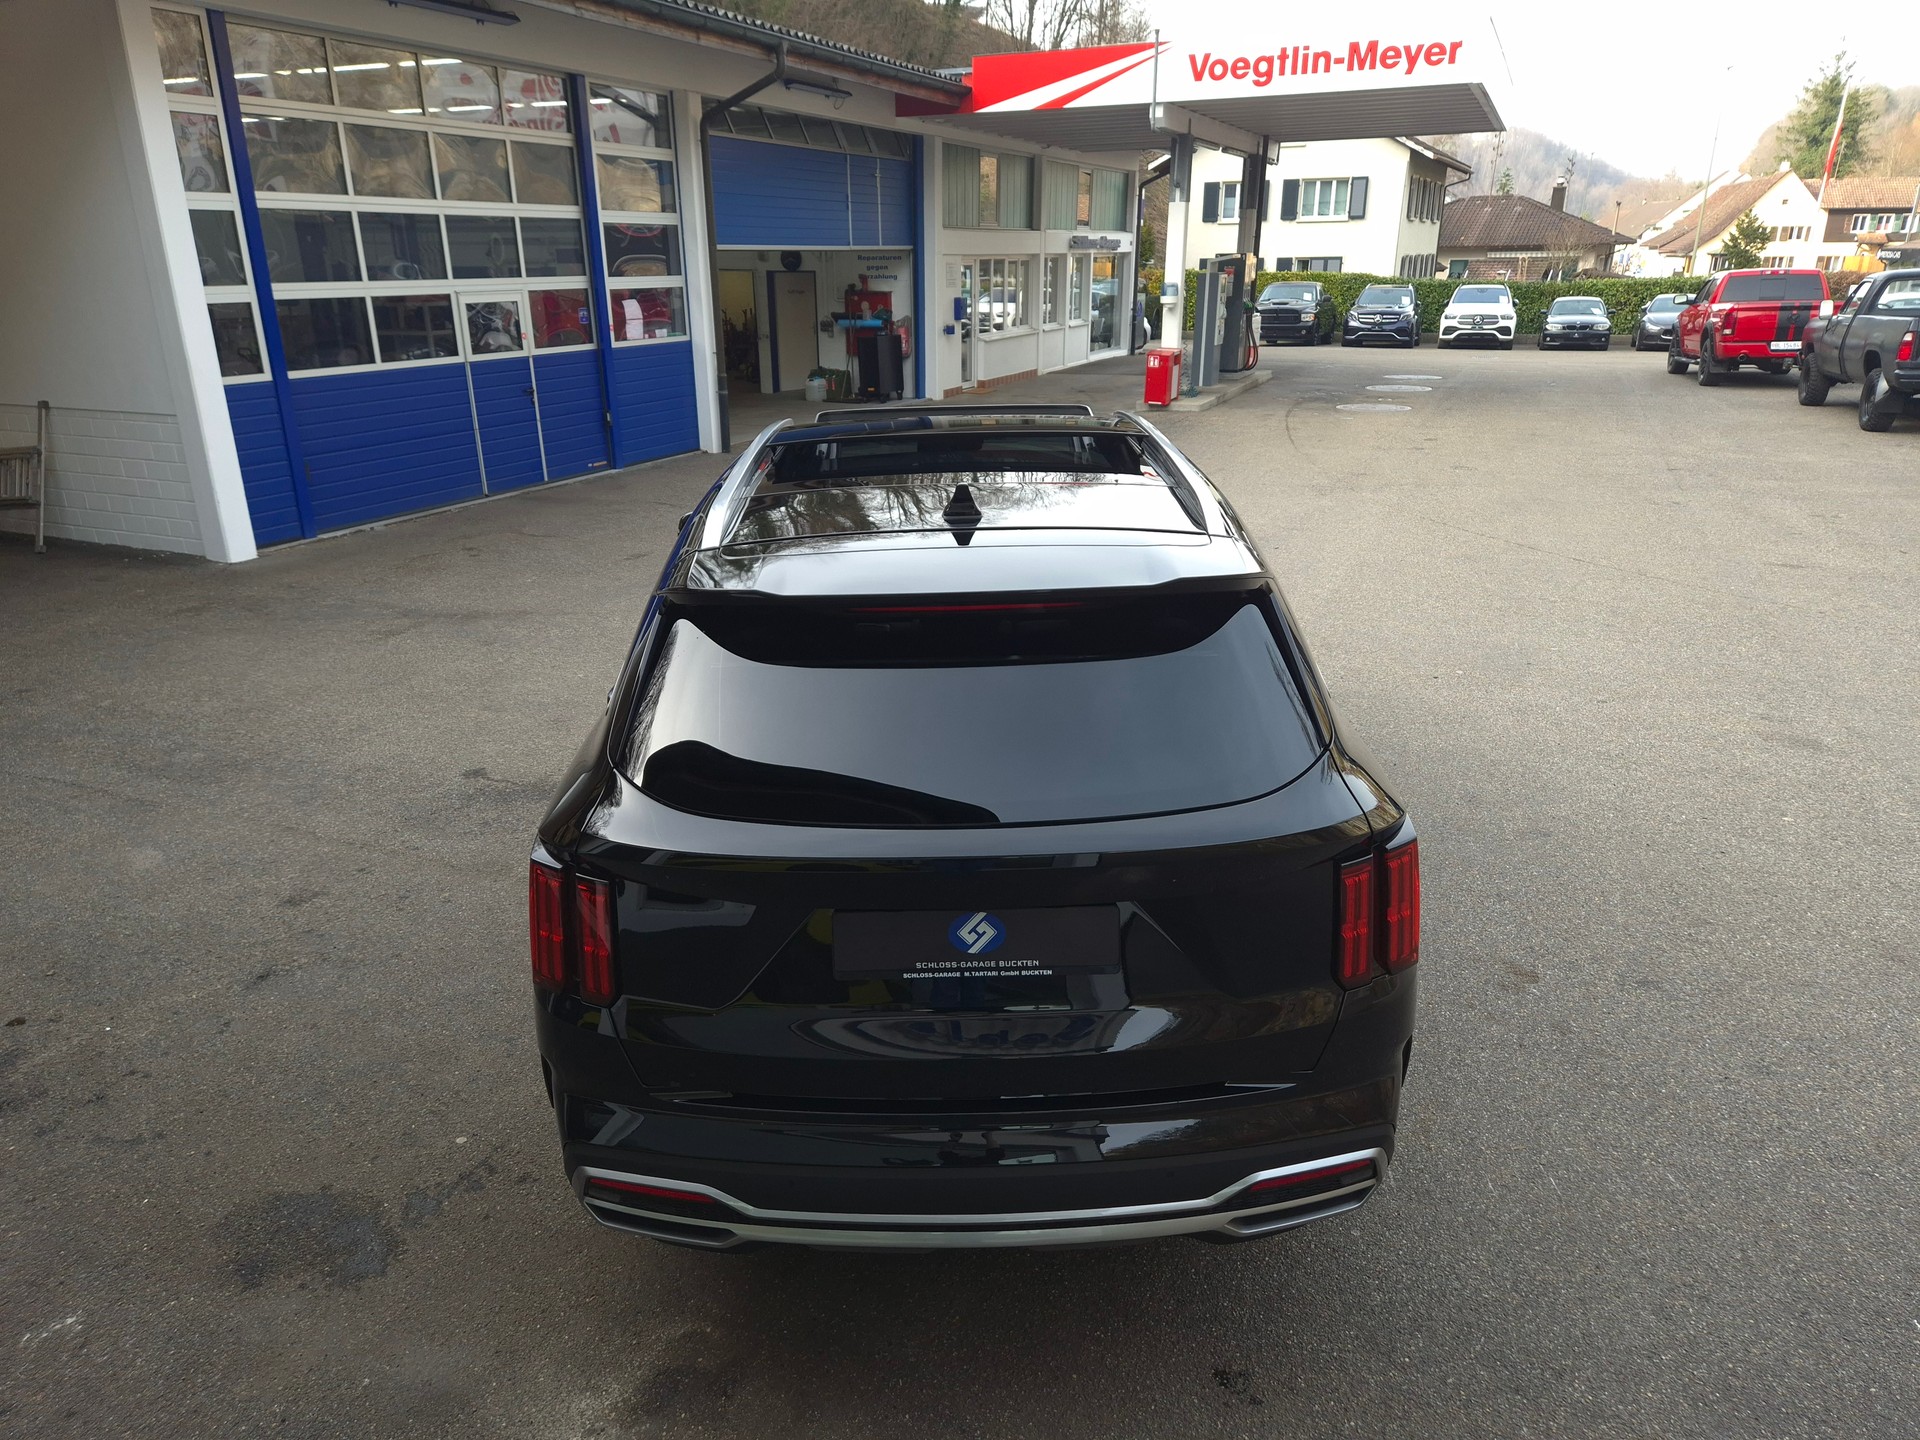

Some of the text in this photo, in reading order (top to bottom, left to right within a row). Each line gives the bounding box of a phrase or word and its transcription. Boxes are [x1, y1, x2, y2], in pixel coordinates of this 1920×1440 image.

[1188, 40, 1463, 87] Voegtlin-Meyer
[857, 254, 902, 262] Reparaturen
[858, 273, 898, 281] rzahlung
[999, 960, 1039, 968] BUCKTEN
